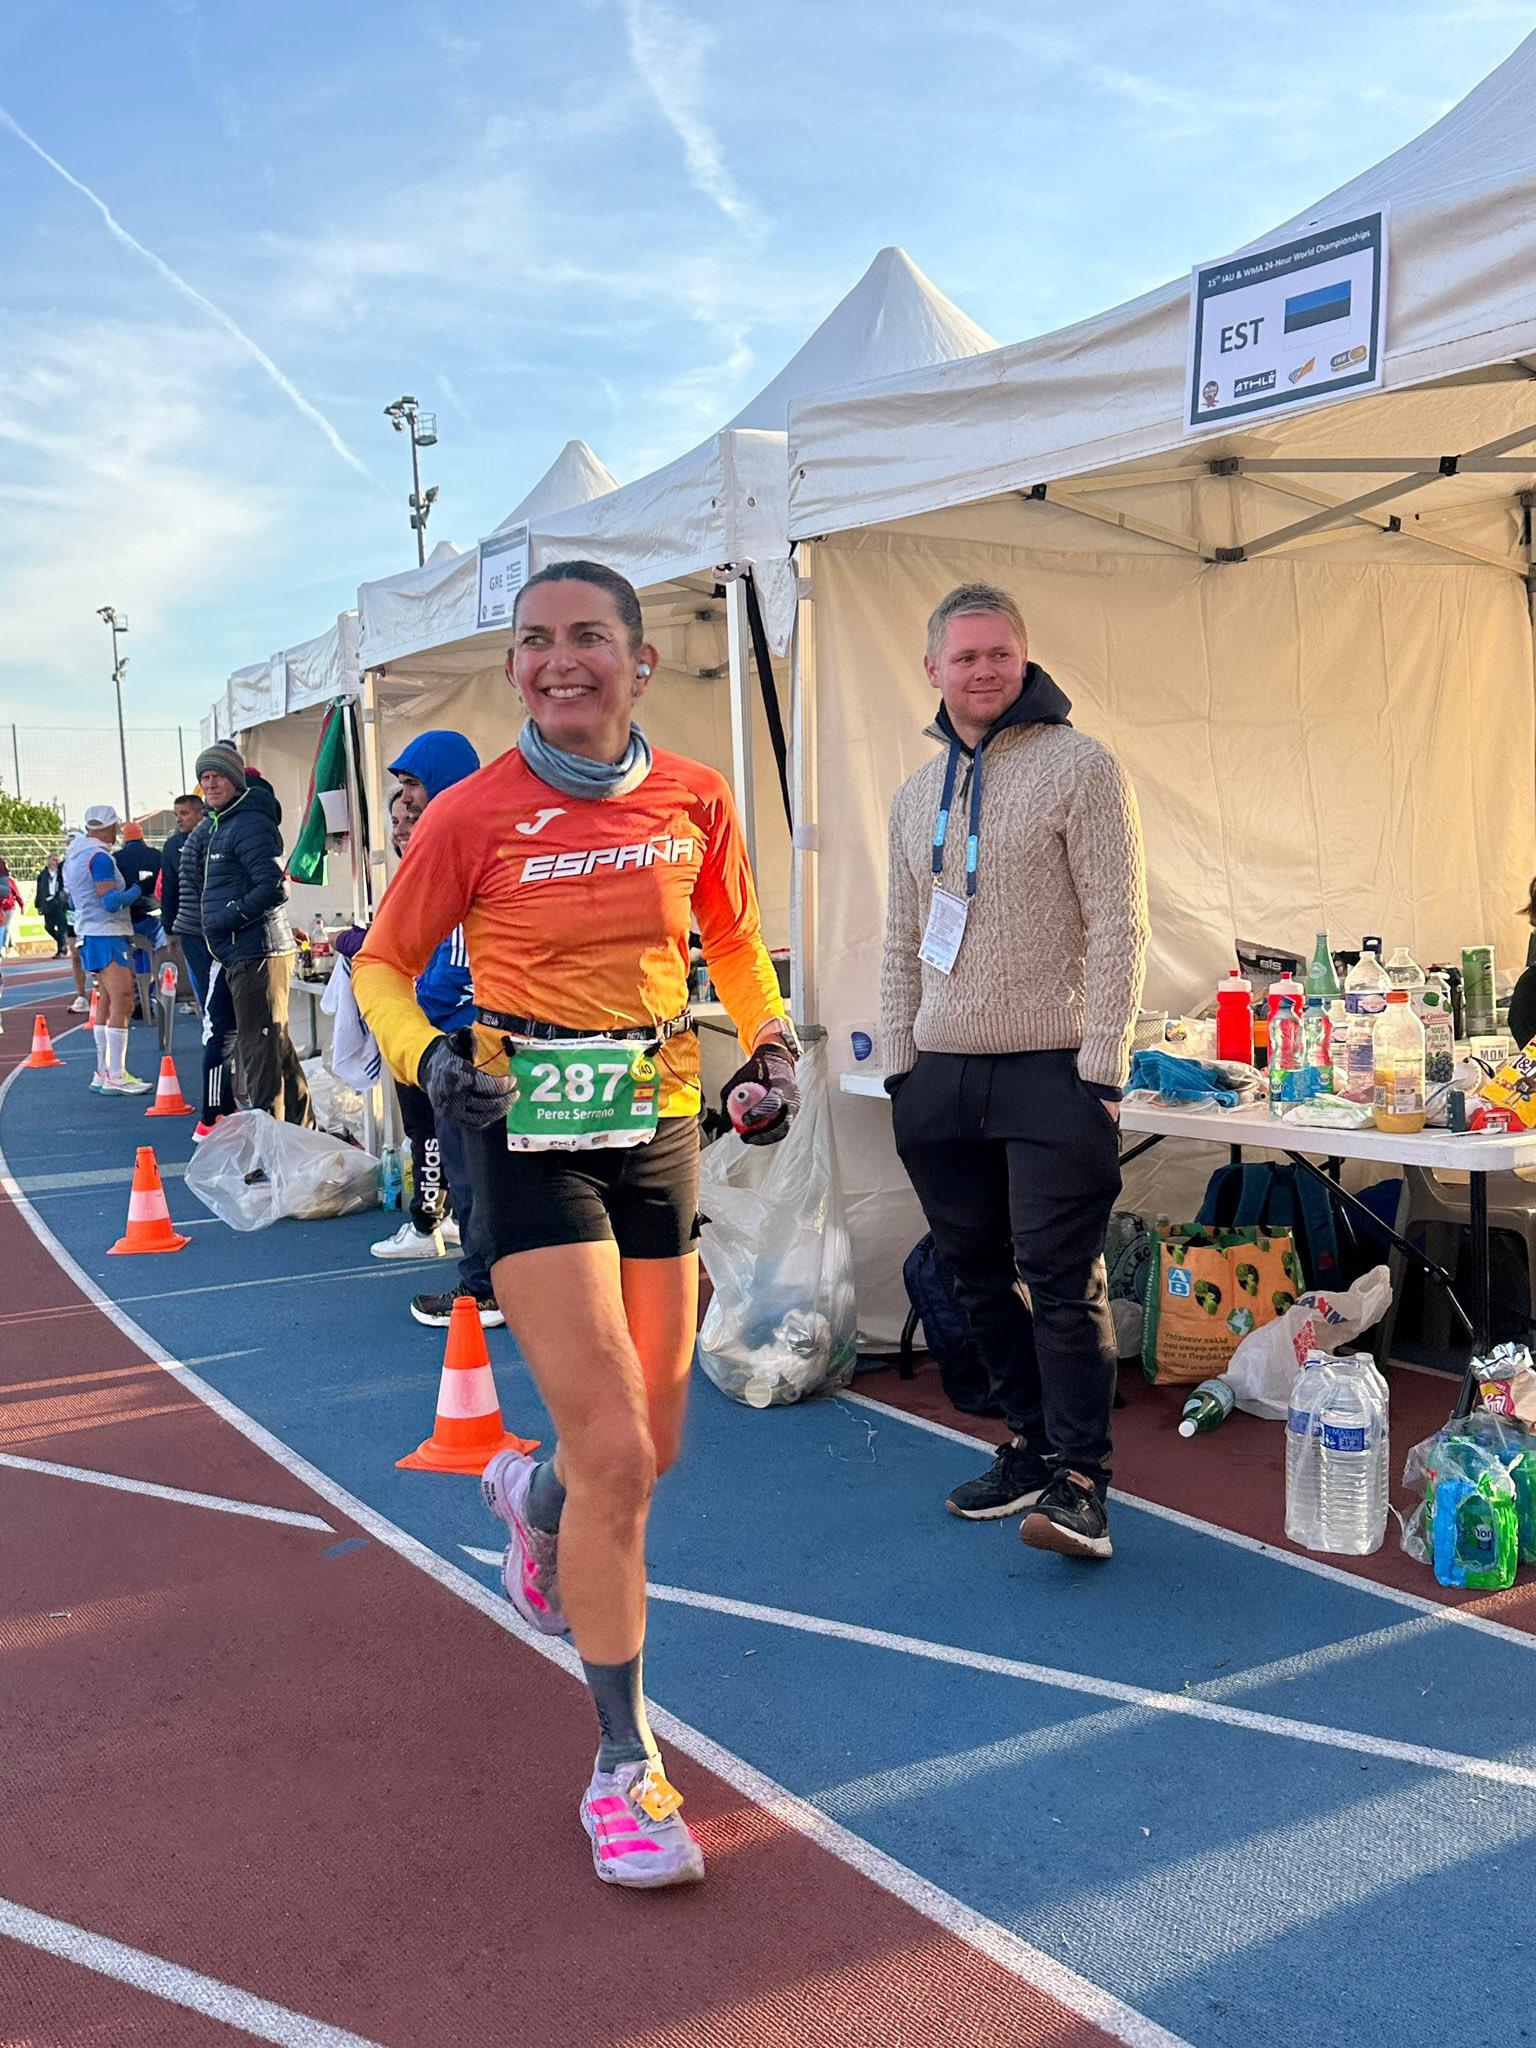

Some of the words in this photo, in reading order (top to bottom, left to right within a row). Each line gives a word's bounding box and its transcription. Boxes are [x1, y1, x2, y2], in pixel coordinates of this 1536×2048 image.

[1222, 273, 1235, 284] IAU
[1236, 270, 1243, 280] &
[1243, 264, 1264, 277] WMA
[1264, 256, 1293, 271] 24-Hour
[1293, 246, 1315, 261] World
[1316, 230, 1371, 254] Championships
[1220, 317, 1265, 354] EST
[489, 574, 504, 591] GRE
[519, 835, 695, 884] ESPAÑA
[530, 1063, 629, 1103] 287
[537, 1108, 570, 1121] Perez
[572, 1108, 614, 1120] Serrano
[421, 1138, 441, 1214] adidas
